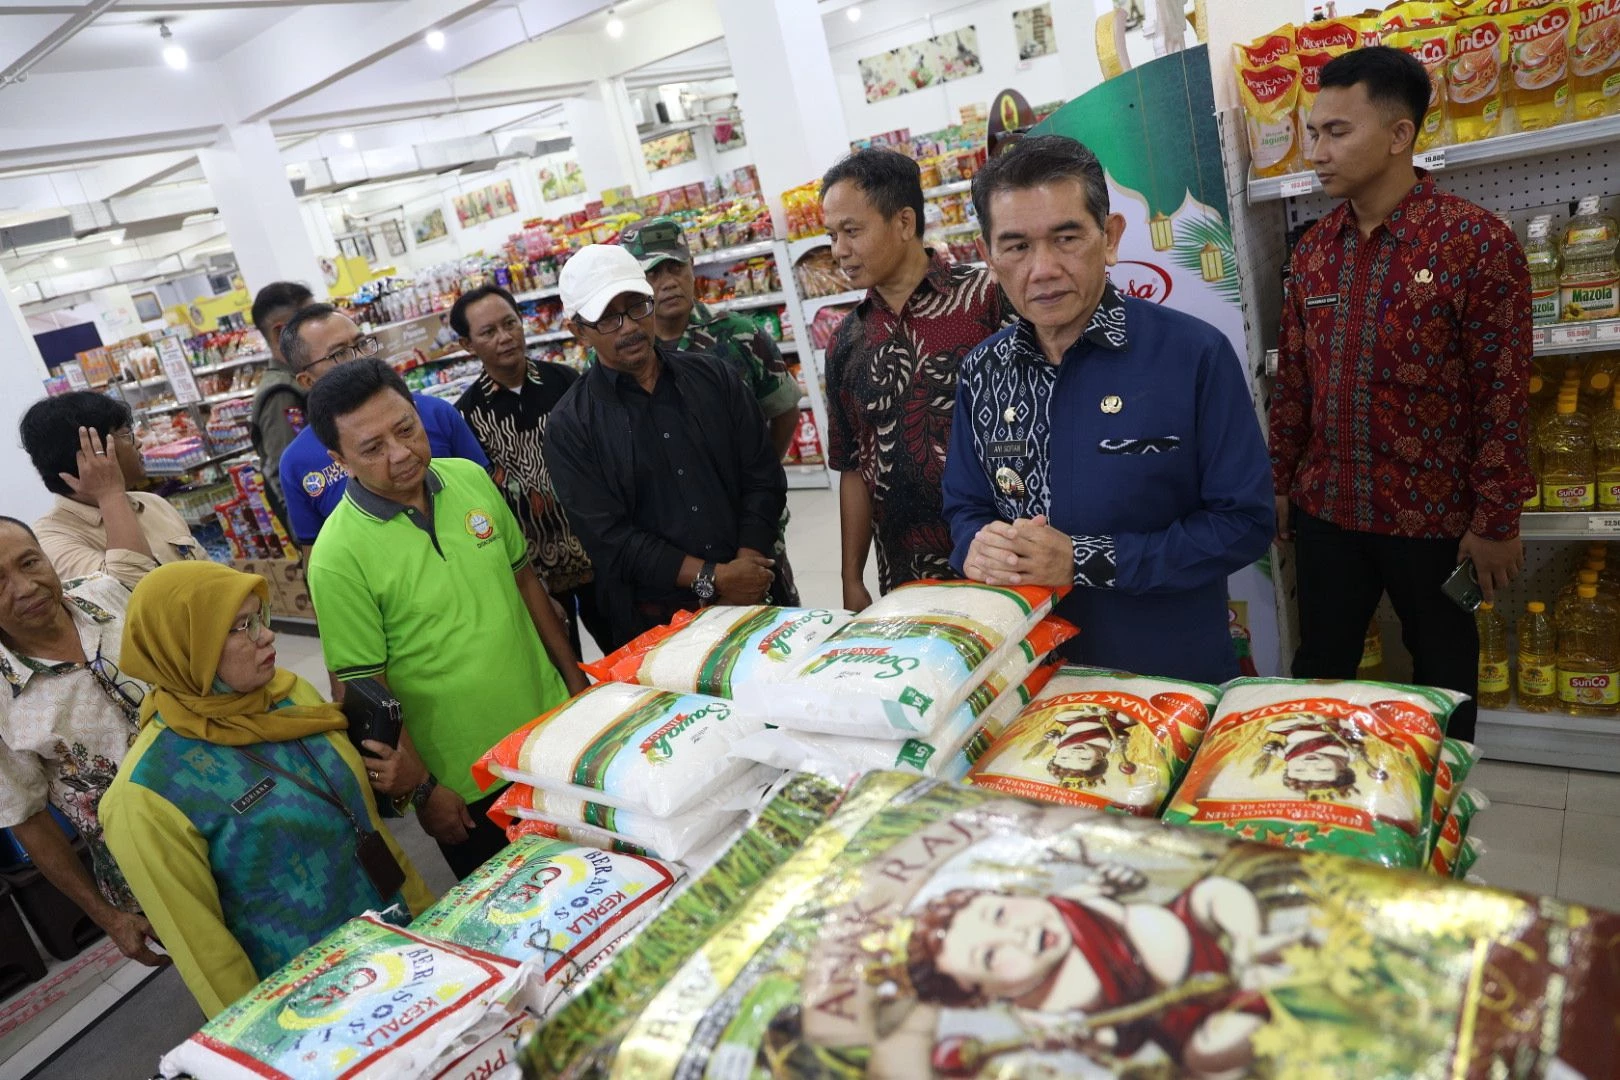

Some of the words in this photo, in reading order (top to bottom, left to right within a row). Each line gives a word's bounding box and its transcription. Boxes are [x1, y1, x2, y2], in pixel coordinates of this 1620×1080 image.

[1302, 33, 1354, 50] TROPICANA
[1256, 86, 1277, 97] SLIM
[1262, 134, 1289, 146] Jagung
[1572, 287, 1613, 302] Mazola
[1532, 301, 1555, 313] azola
[1558, 487, 1584, 497] SunCo
[810, 653, 920, 680] Sawah
[1572, 676, 1607, 687] SunCo
[1104, 693, 1159, 723] ANAK
[1241, 702, 1307, 722] RAJA
[654, 702, 731, 758] Sawah
[914, 746, 928, 758] 5
[584, 850, 613, 896] BERAS
[508, 866, 562, 904] CK
[565, 890, 628, 935] KEPALA
[356, 996, 440, 1047] KEPALA
